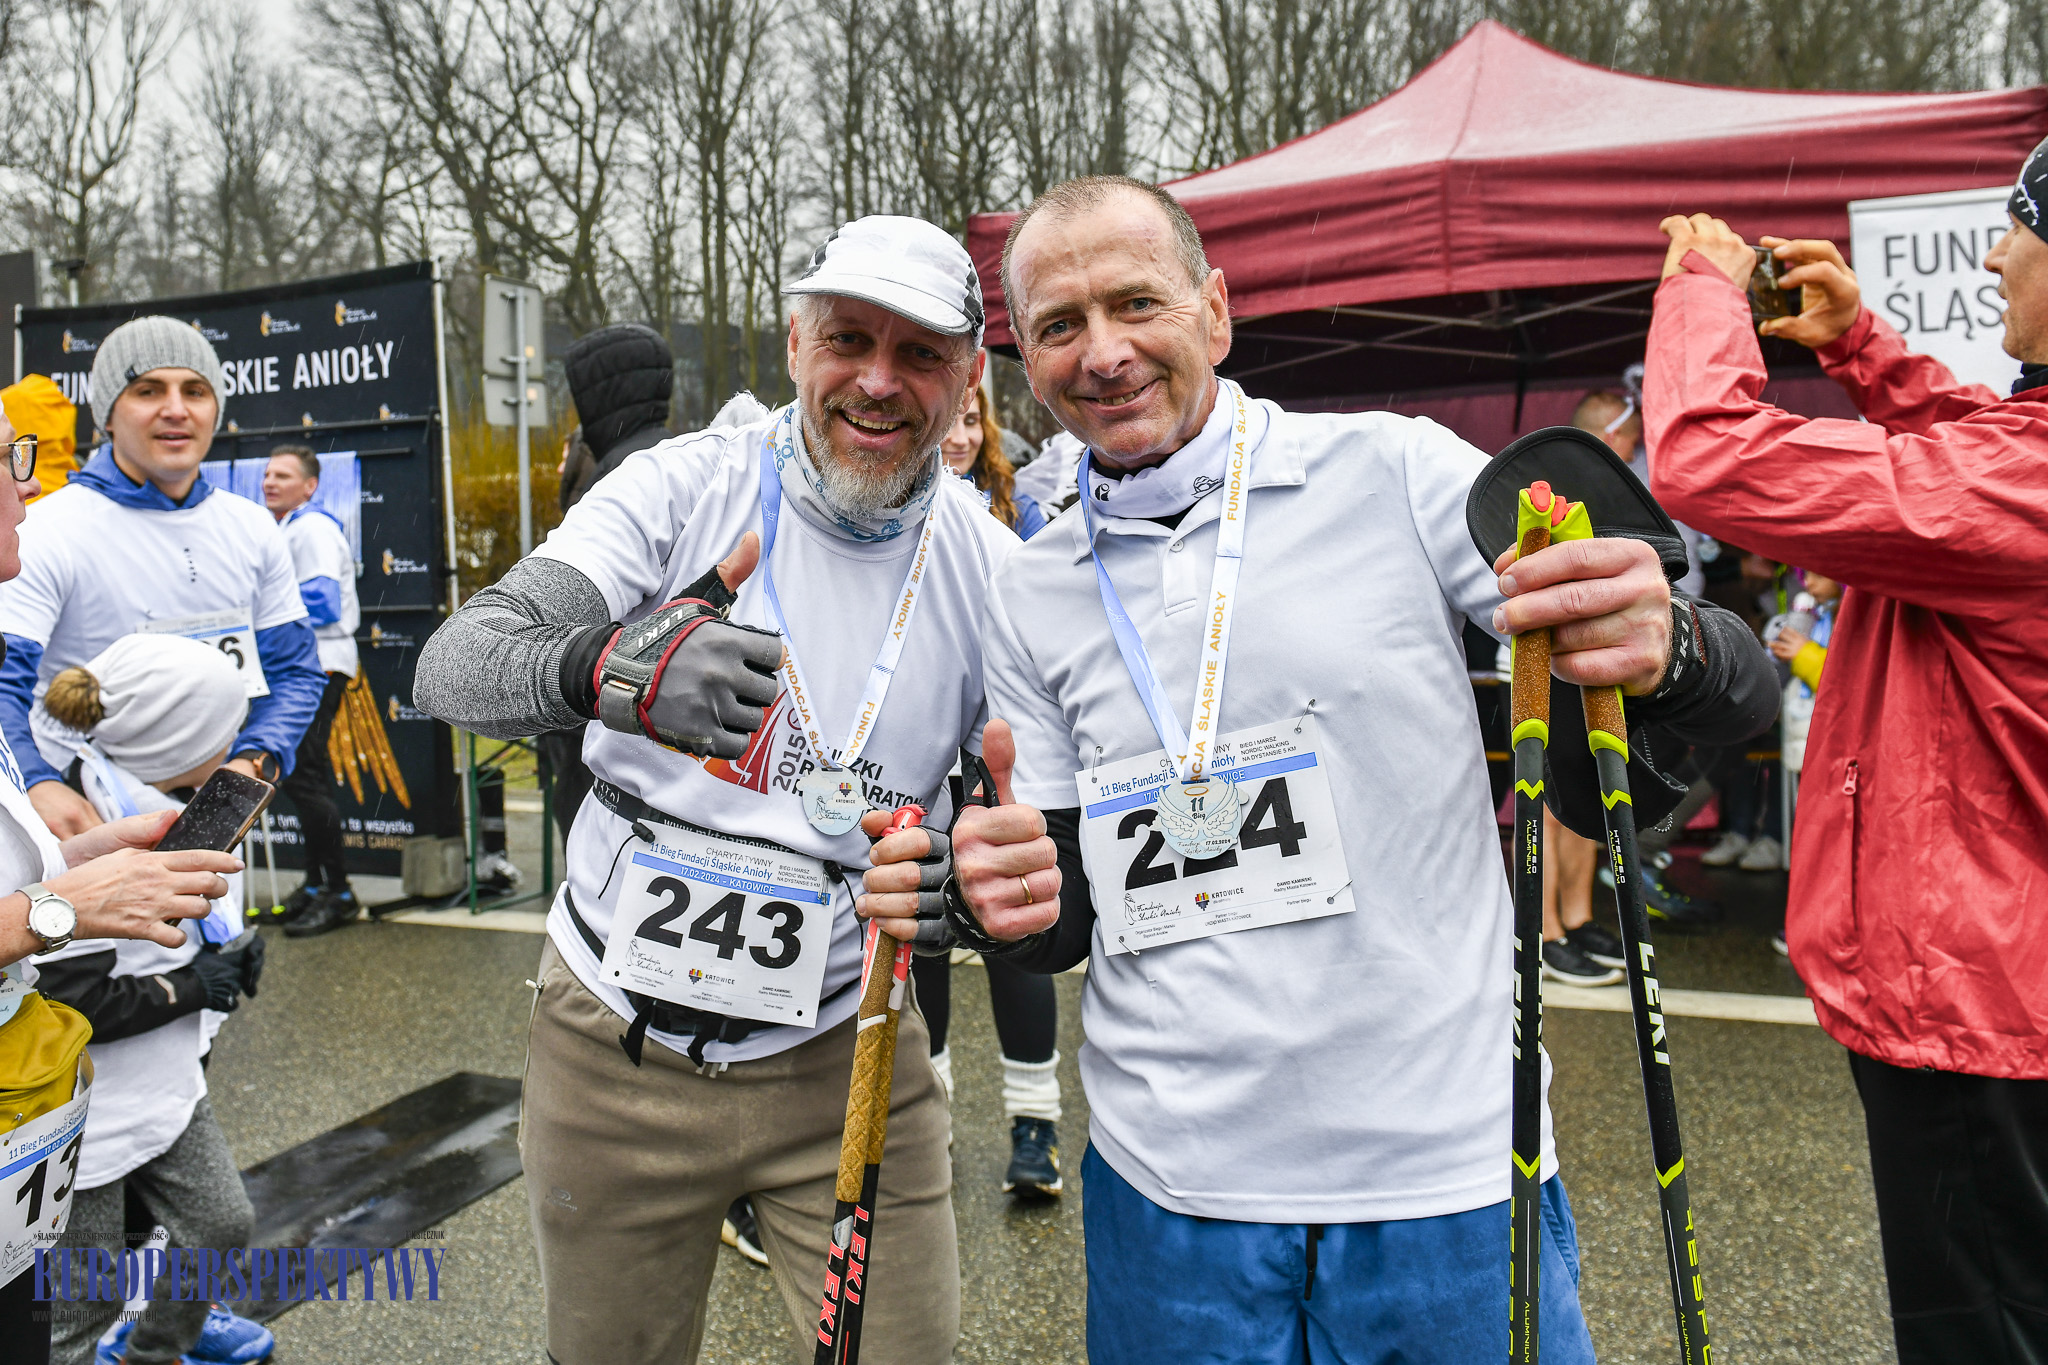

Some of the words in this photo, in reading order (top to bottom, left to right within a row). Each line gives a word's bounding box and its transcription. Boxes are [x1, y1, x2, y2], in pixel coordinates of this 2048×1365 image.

[1886, 281, 2002, 340] ŚLĄS
[220, 356, 281, 397] SKIE
[292, 341, 395, 390] ANIOŁY
[1227, 442, 1245, 521] FUNDACJA
[638, 608, 683, 649] LEKI
[893, 588, 914, 640] ANIOŁY
[1196, 660, 1217, 731] ŚLĄSKIE
[1210, 591, 1226, 651] ANIOŁY
[772, 733, 806, 791] 2015
[1264, 740, 1289, 750] WALKING
[1100, 786, 1110, 797] 11
[1112, 781, 1131, 796] Bieg
[1132, 769, 1168, 792] Fundacji
[1210, 754, 1236, 769] nioły
[1191, 796, 1204, 812] 11
[1192, 812, 1205, 820] Bieg
[650, 842, 660, 853] 11
[660, 844, 676, 860] Bieg
[677, 849, 711, 868] Fundacji
[711, 856, 742, 874] Śląskie
[743, 864, 773, 881] Anioły
[680, 866, 720, 884] 17.02.2024
[730, 877, 775, 894] KATOWICE
[706, 847, 773, 868] CHARYTATYWNY
[1609, 830, 1620, 884] ALUMINIUM
[1211, 887, 1245, 899] KATOWICE
[635, 876, 804, 969] 243
[705, 974, 735, 985] KATOWICE
[1638, 941, 1670, 1066] LEKI
[9, 1148, 18, 1160] 11
[20, 1142, 37, 1154] Bieg
[845, 1204, 869, 1305] LEKI
[817, 1239, 845, 1346] LEKI
